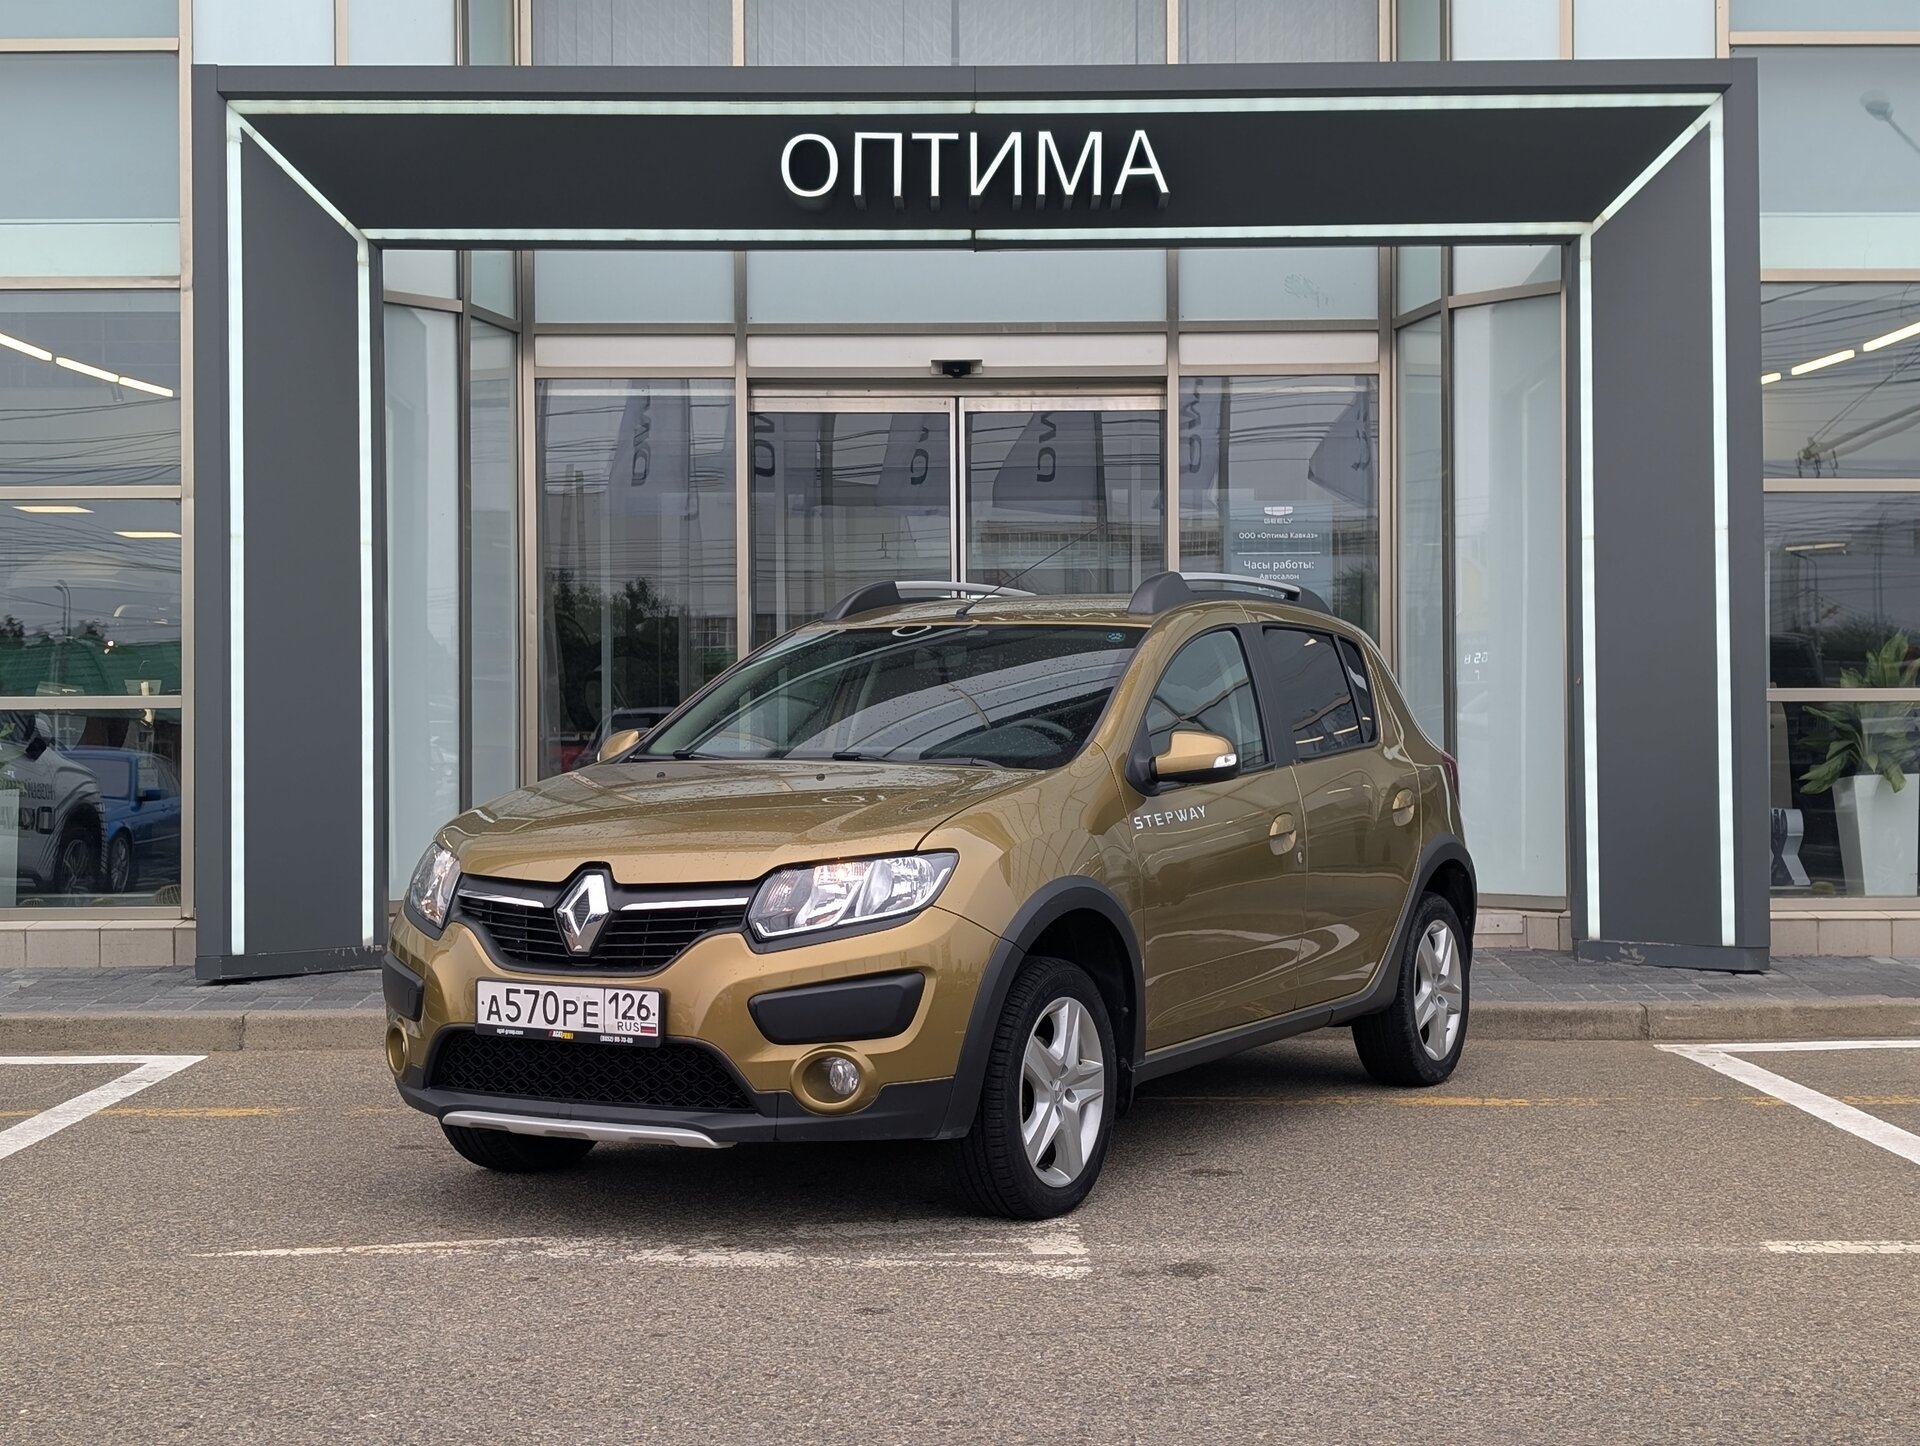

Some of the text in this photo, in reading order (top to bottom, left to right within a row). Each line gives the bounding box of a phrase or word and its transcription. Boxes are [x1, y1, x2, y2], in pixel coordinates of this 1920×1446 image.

[781, 130, 1169, 198] ОПТИМА
[1263, 517, 1293, 525] GEELY
[1238, 532, 1256, 540] ООО
[1257, 532, 1289, 540] «Оптима
[1243, 559, 1315, 572] Часы работы:
[1259, 573, 1300, 581] Автосалон
[1133, 805, 1206, 830] STEPWAY
[486, 988, 651, 1029] А570РЕ 126
[617, 1021, 640, 1032] RUS
